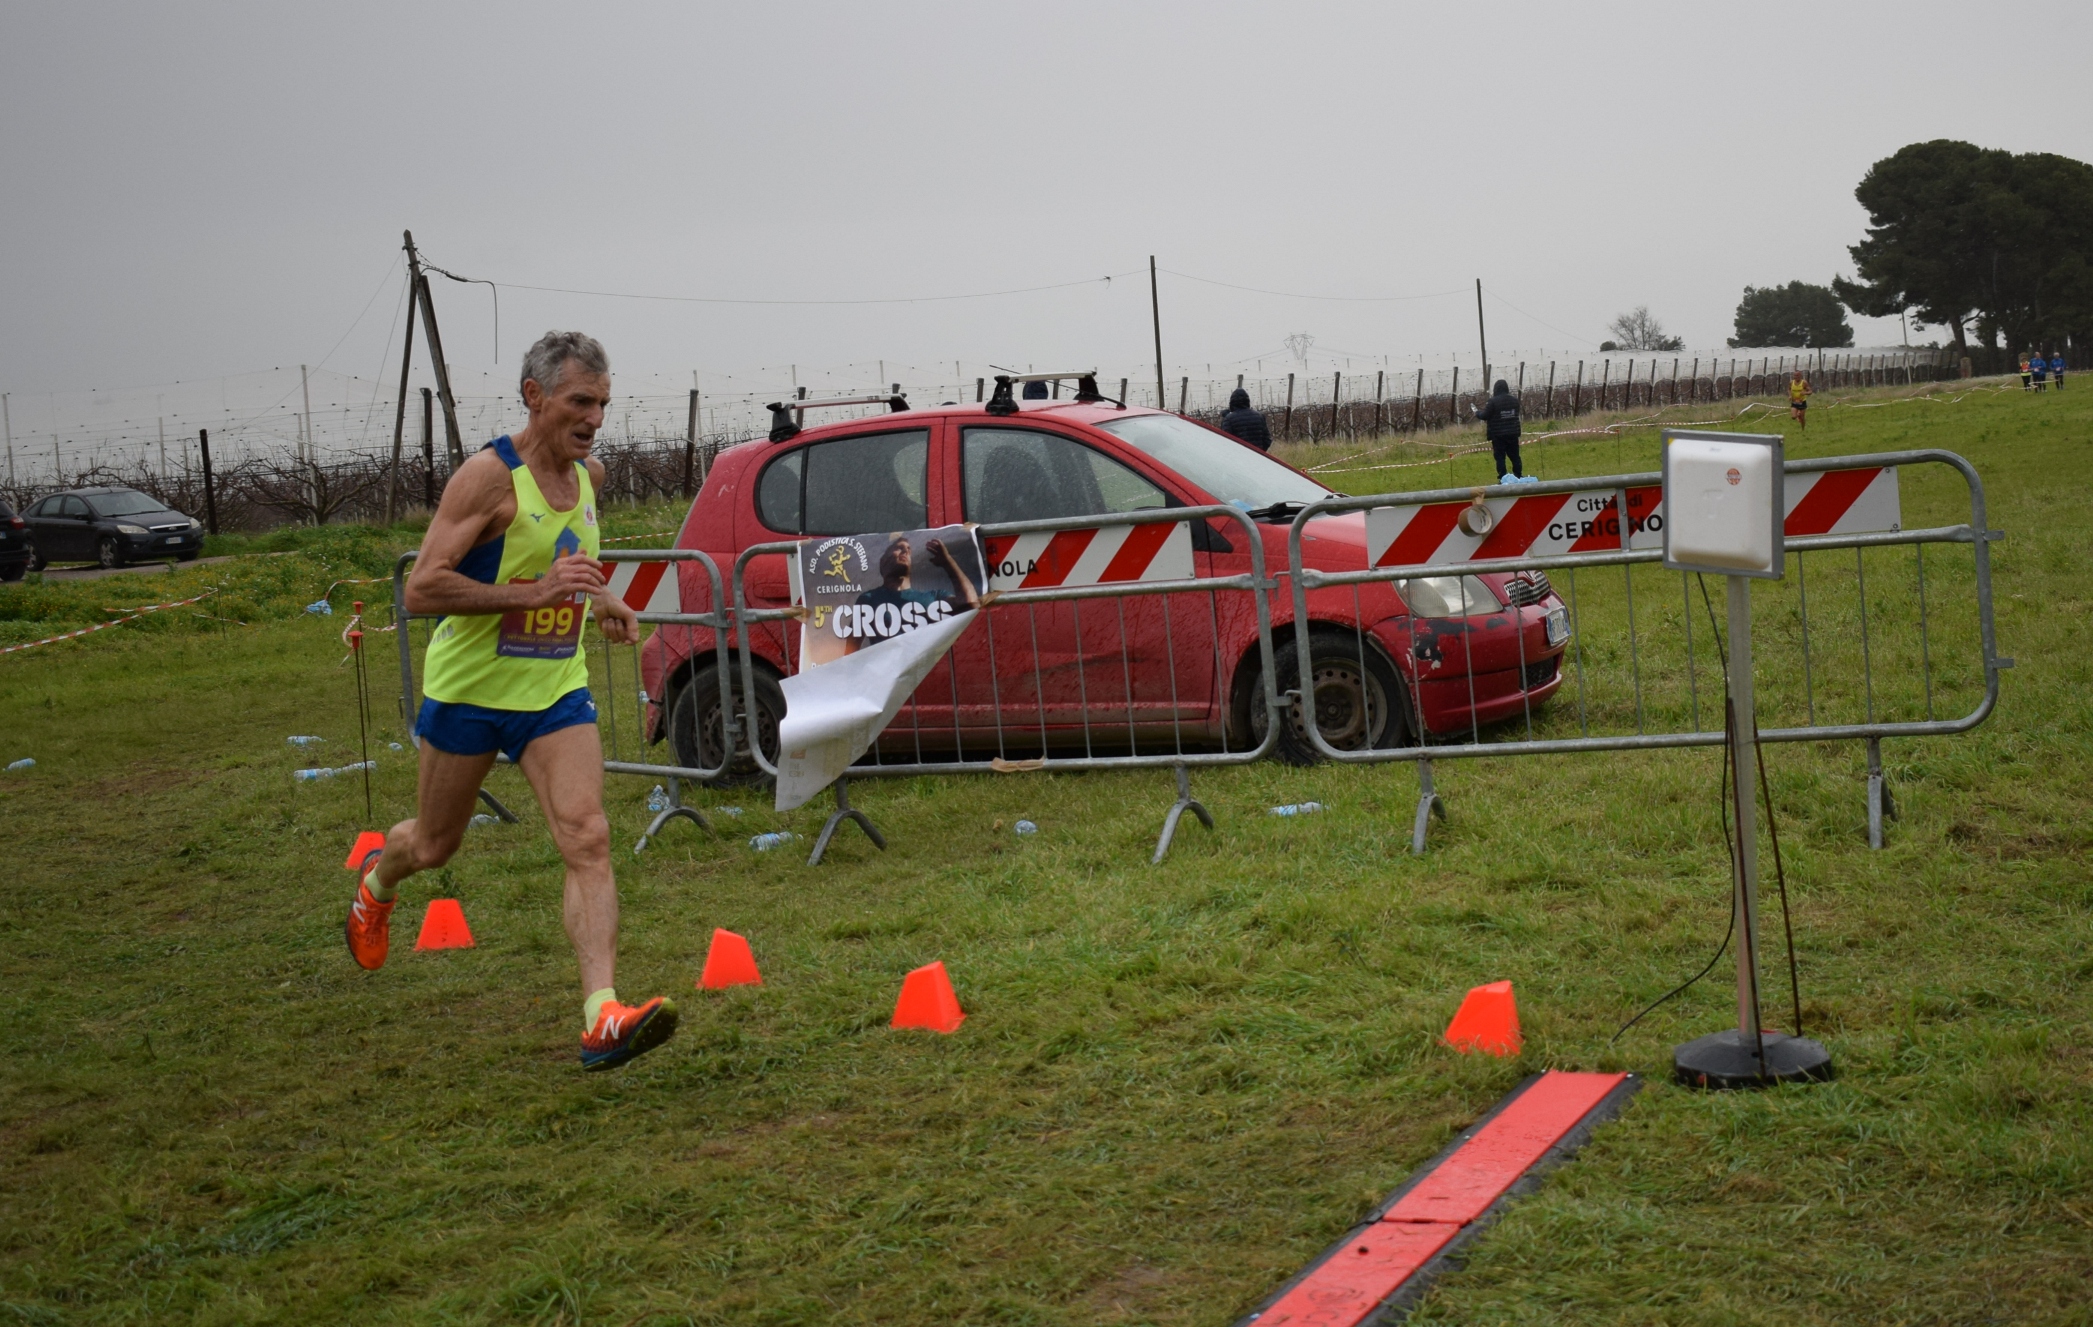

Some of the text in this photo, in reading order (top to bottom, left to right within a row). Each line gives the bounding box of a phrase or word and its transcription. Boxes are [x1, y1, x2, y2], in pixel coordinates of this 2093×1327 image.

[1629, 494, 1643, 508] di
[853, 541, 869, 572] STEFANO
[816, 584, 862, 594] CERIGNOLA
[524, 607, 574, 636] 199
[832, 600, 953, 638] CROSS
